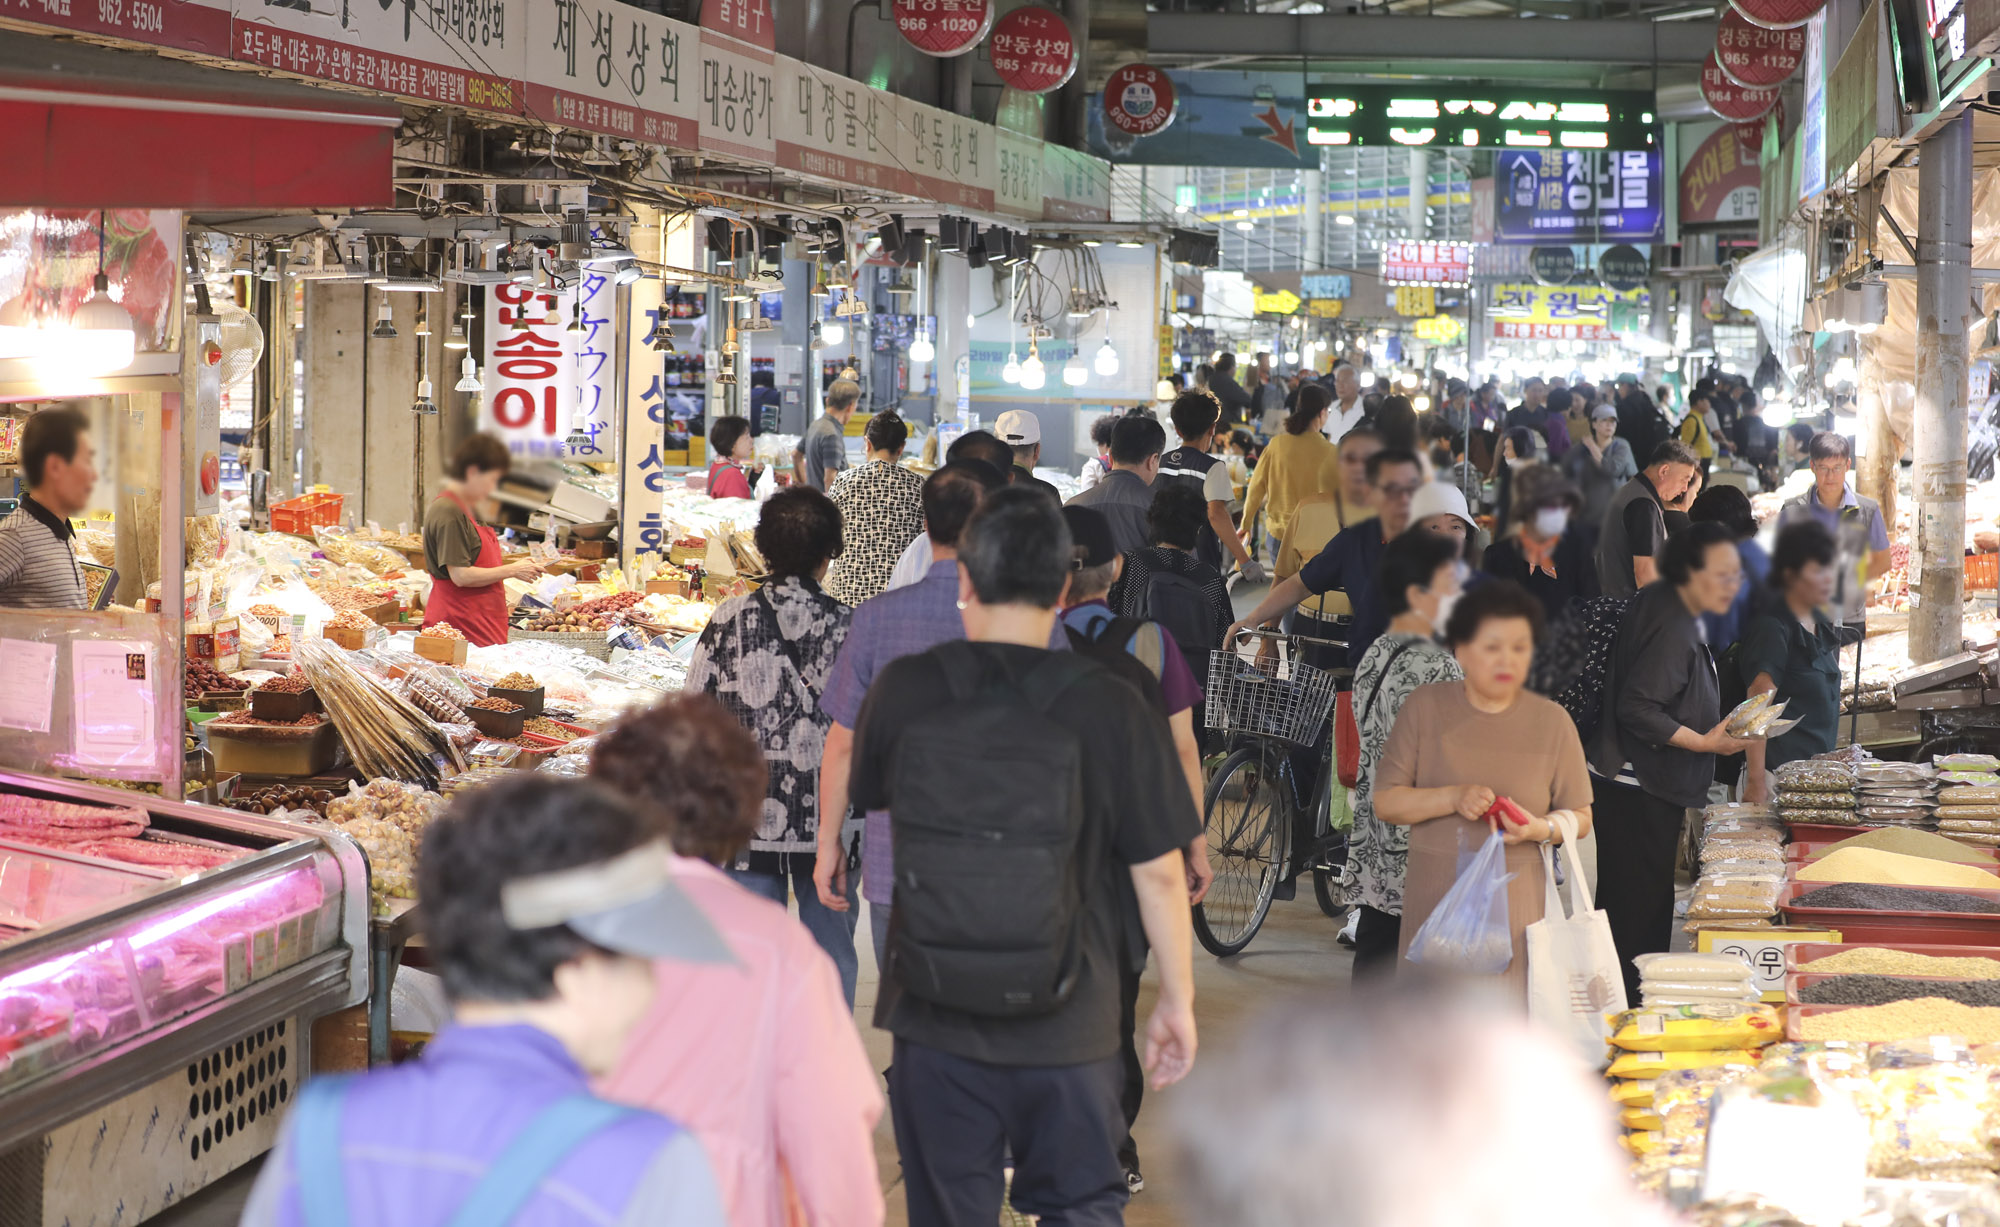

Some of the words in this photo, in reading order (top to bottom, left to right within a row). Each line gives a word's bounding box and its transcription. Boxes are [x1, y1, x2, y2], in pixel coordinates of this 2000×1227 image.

[553, 0, 680, 103] 제성상회
[994, 34, 1070, 60] 안동상회
[1720, 28, 1804, 51] 경동건어물
[422, 68, 465, 102] 건어물일체
[703, 58, 774, 140] 대송상가
[798, 75, 878, 152] 대정물산
[913, 111, 979, 178] 안동상회
[1731, 191, 1757, 217] 입구
